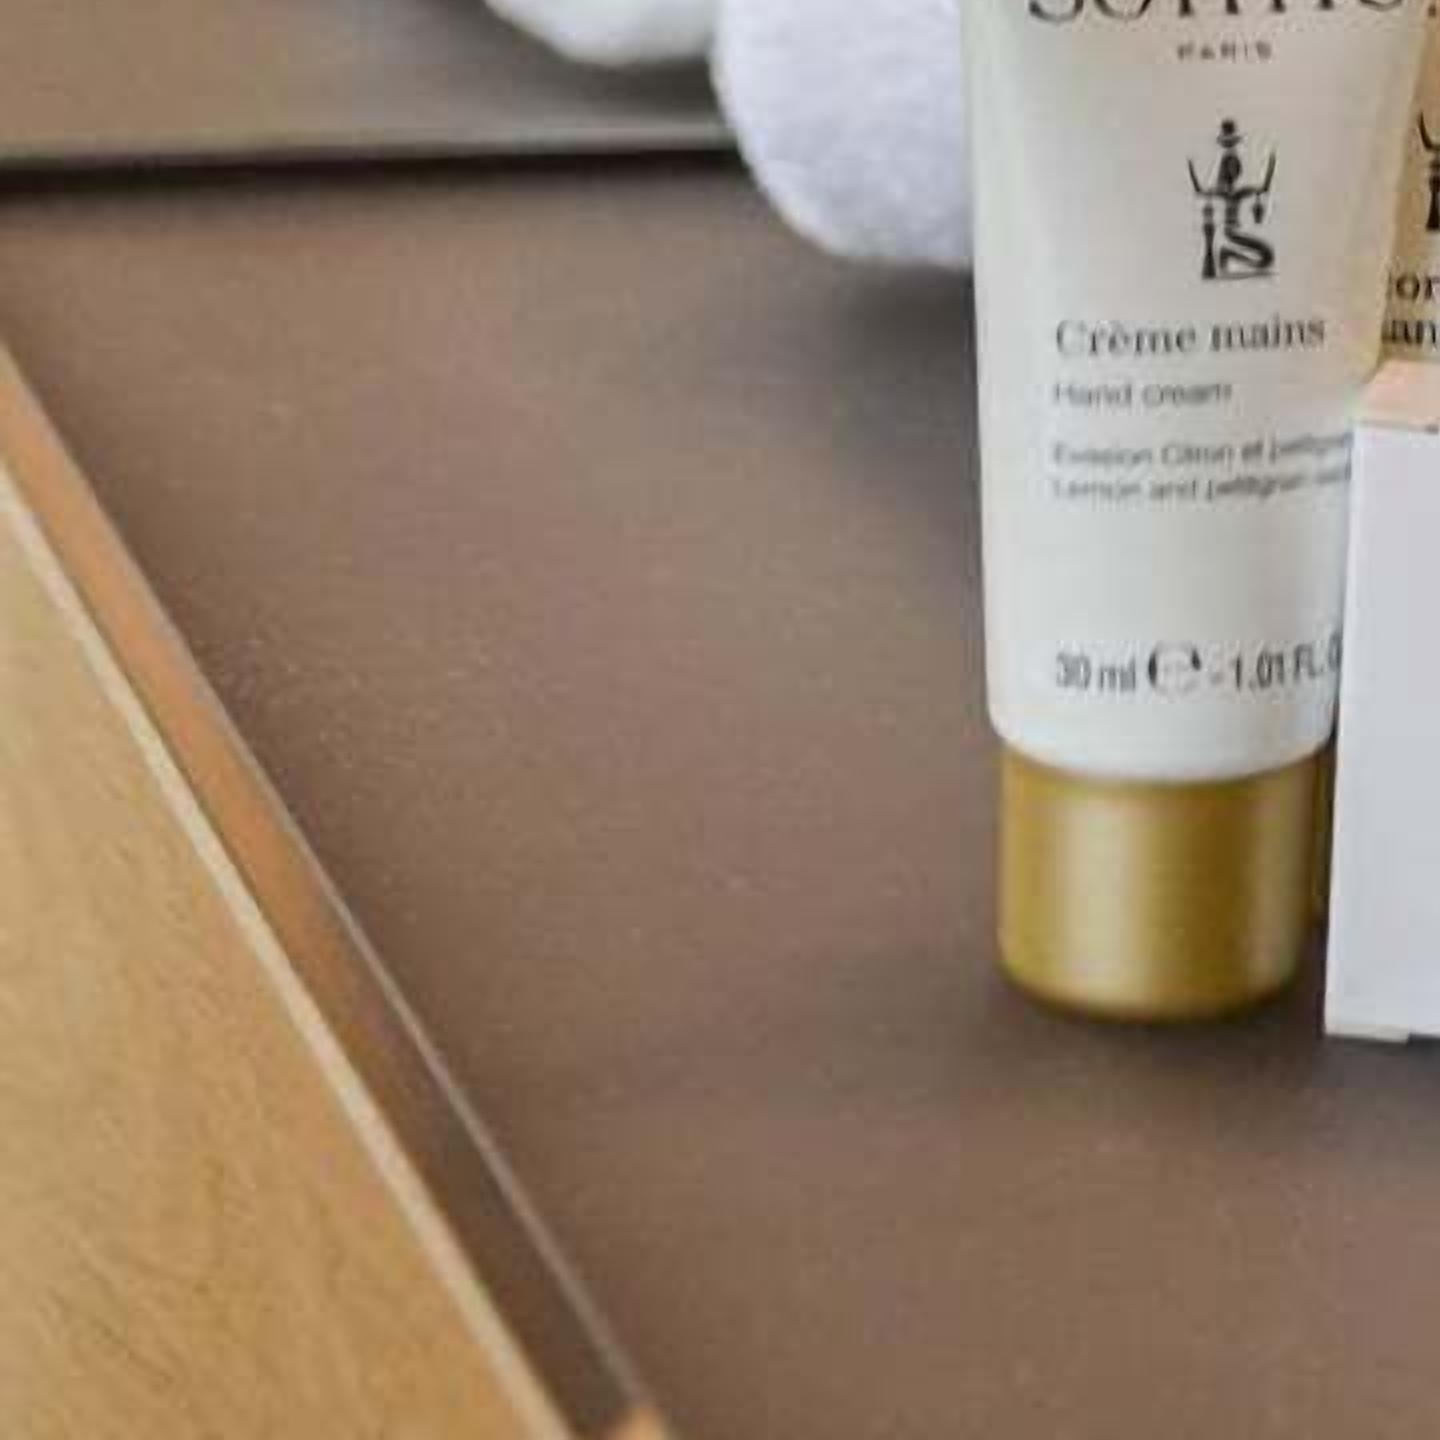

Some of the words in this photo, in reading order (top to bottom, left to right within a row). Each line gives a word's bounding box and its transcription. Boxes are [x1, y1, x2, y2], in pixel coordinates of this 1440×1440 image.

[1177, 42, 1272, 62] PARIS
[1055, 318, 1196, 356] Crème
[1208, 315, 1325, 351] mains
[1054, 382, 1131, 407] Hand
[1142, 382, 1234, 407] cream
[1055, 652, 1091, 689] 30
[1098, 653, 1136, 693] ml
